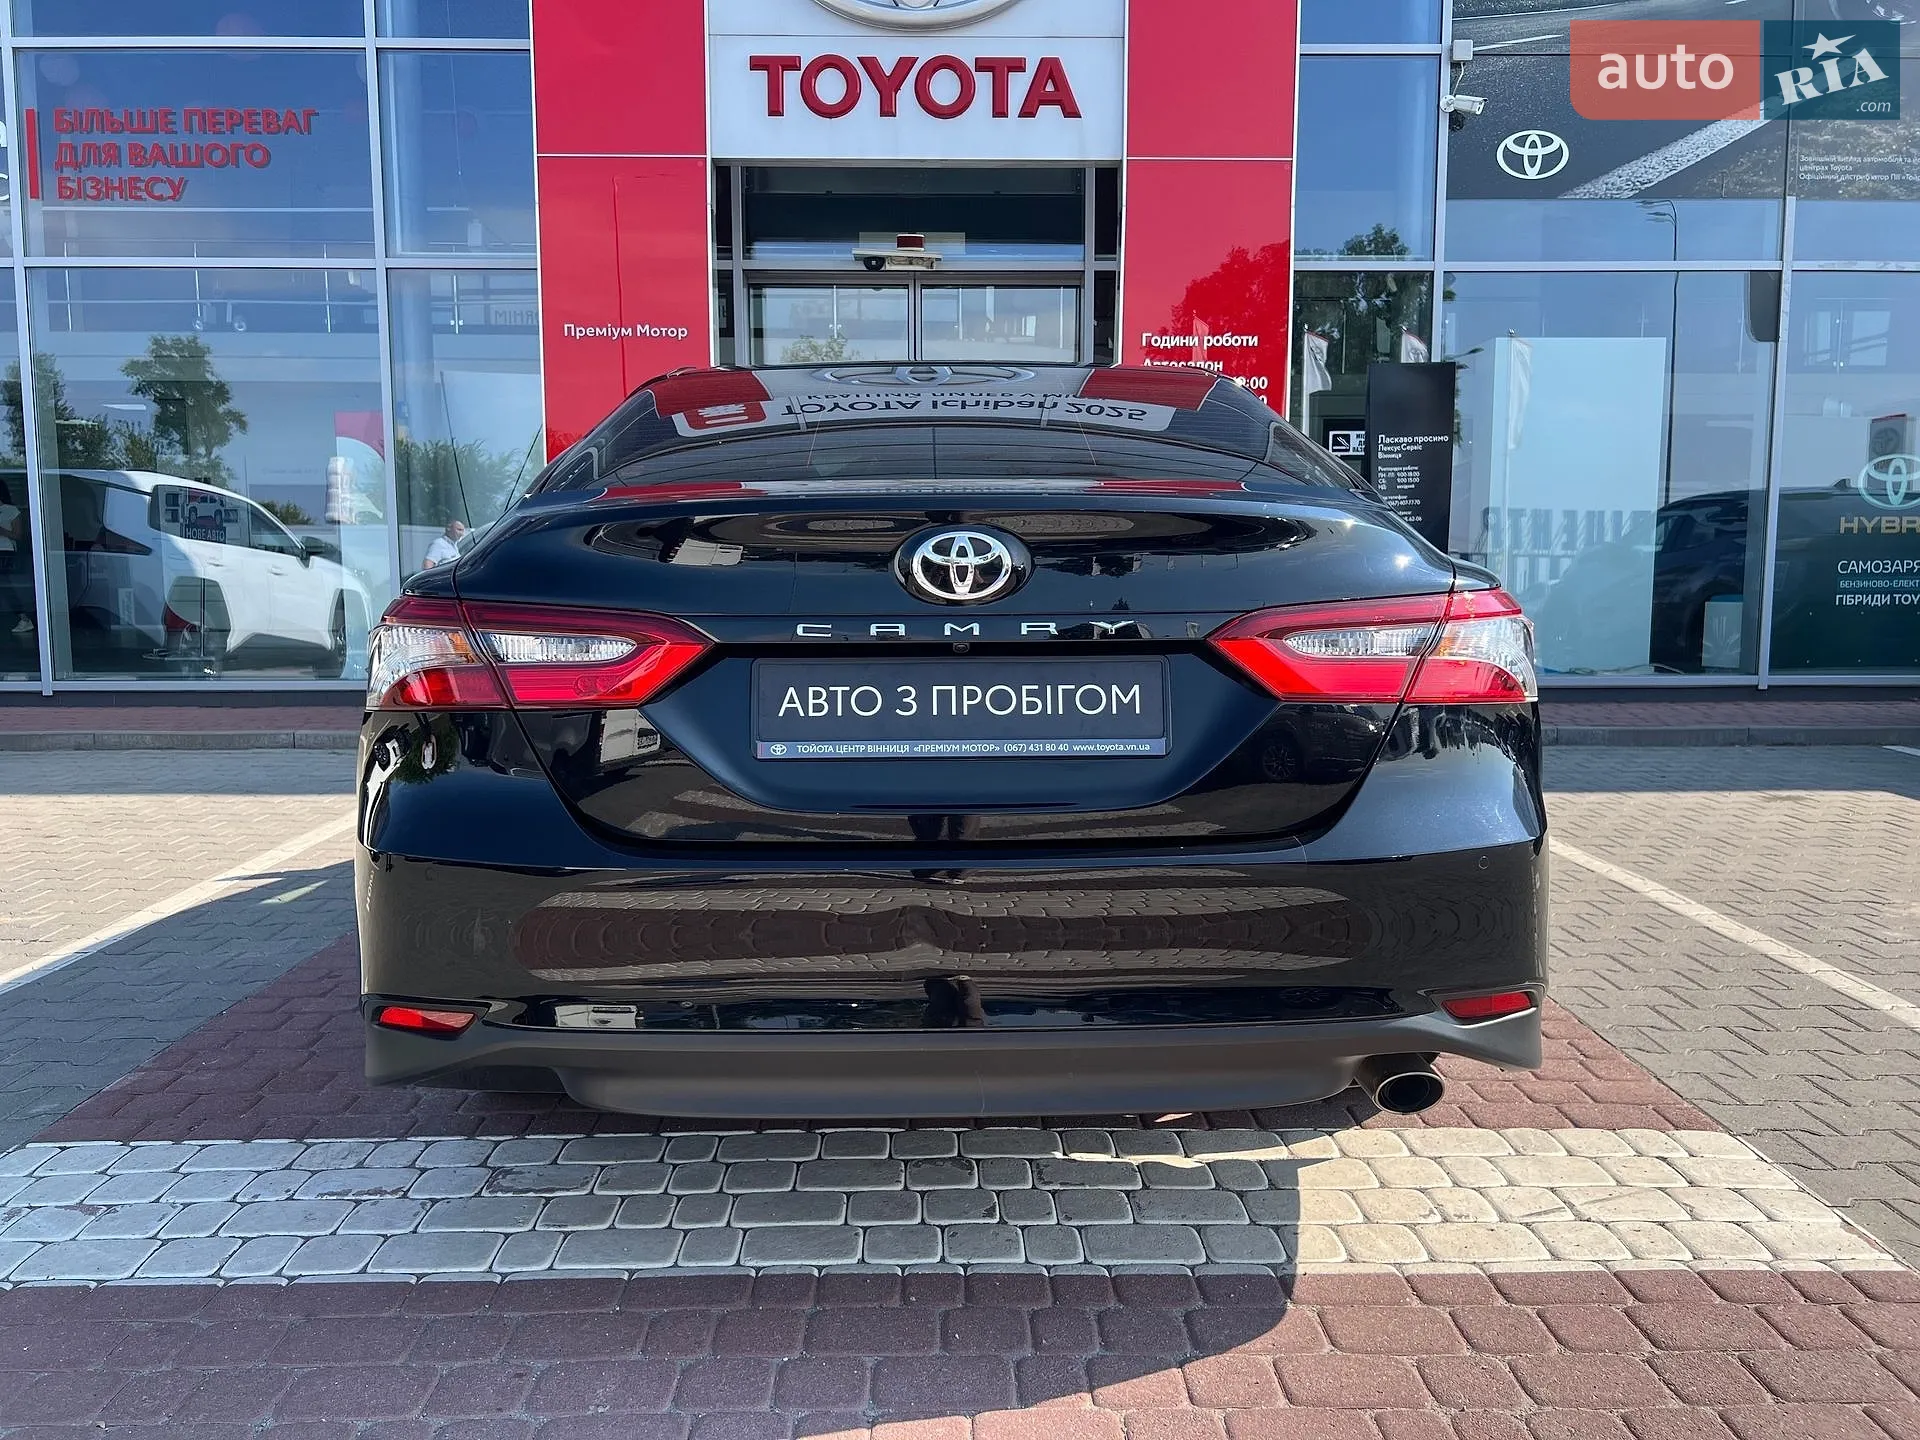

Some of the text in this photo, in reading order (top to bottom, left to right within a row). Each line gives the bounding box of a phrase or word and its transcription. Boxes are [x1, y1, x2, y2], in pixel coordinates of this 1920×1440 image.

[749, 53, 1082, 119] TOYOTA
[54, 107, 319, 135] БІЛЬШЕ ПЕРЕВАГ
[55, 141, 271, 172] ДЛЯ ВАШОГО
[57, 175, 189, 201] БІЗНЕСУ
[563, 323, 688, 340] Преміум Мотор
[1141, 331, 1258, 350] Години роботи
[1378, 434, 1449, 445] Ласкаво просимо
[1839, 516, 1920, 534] HYBR
[1835, 594, 1891, 607] ГІБРИДИ
[796, 620, 1135, 637] CAMRY
[778, 684, 1141, 717] АВТО З ПРОБІГОМ
[796, 742, 1151, 754] ТОЙОТА ЦЕНТР ВІННИЦЯ «ПРЕМІУМ МОТОР» (067) 431 80 40 www.toyota.vn.ua
